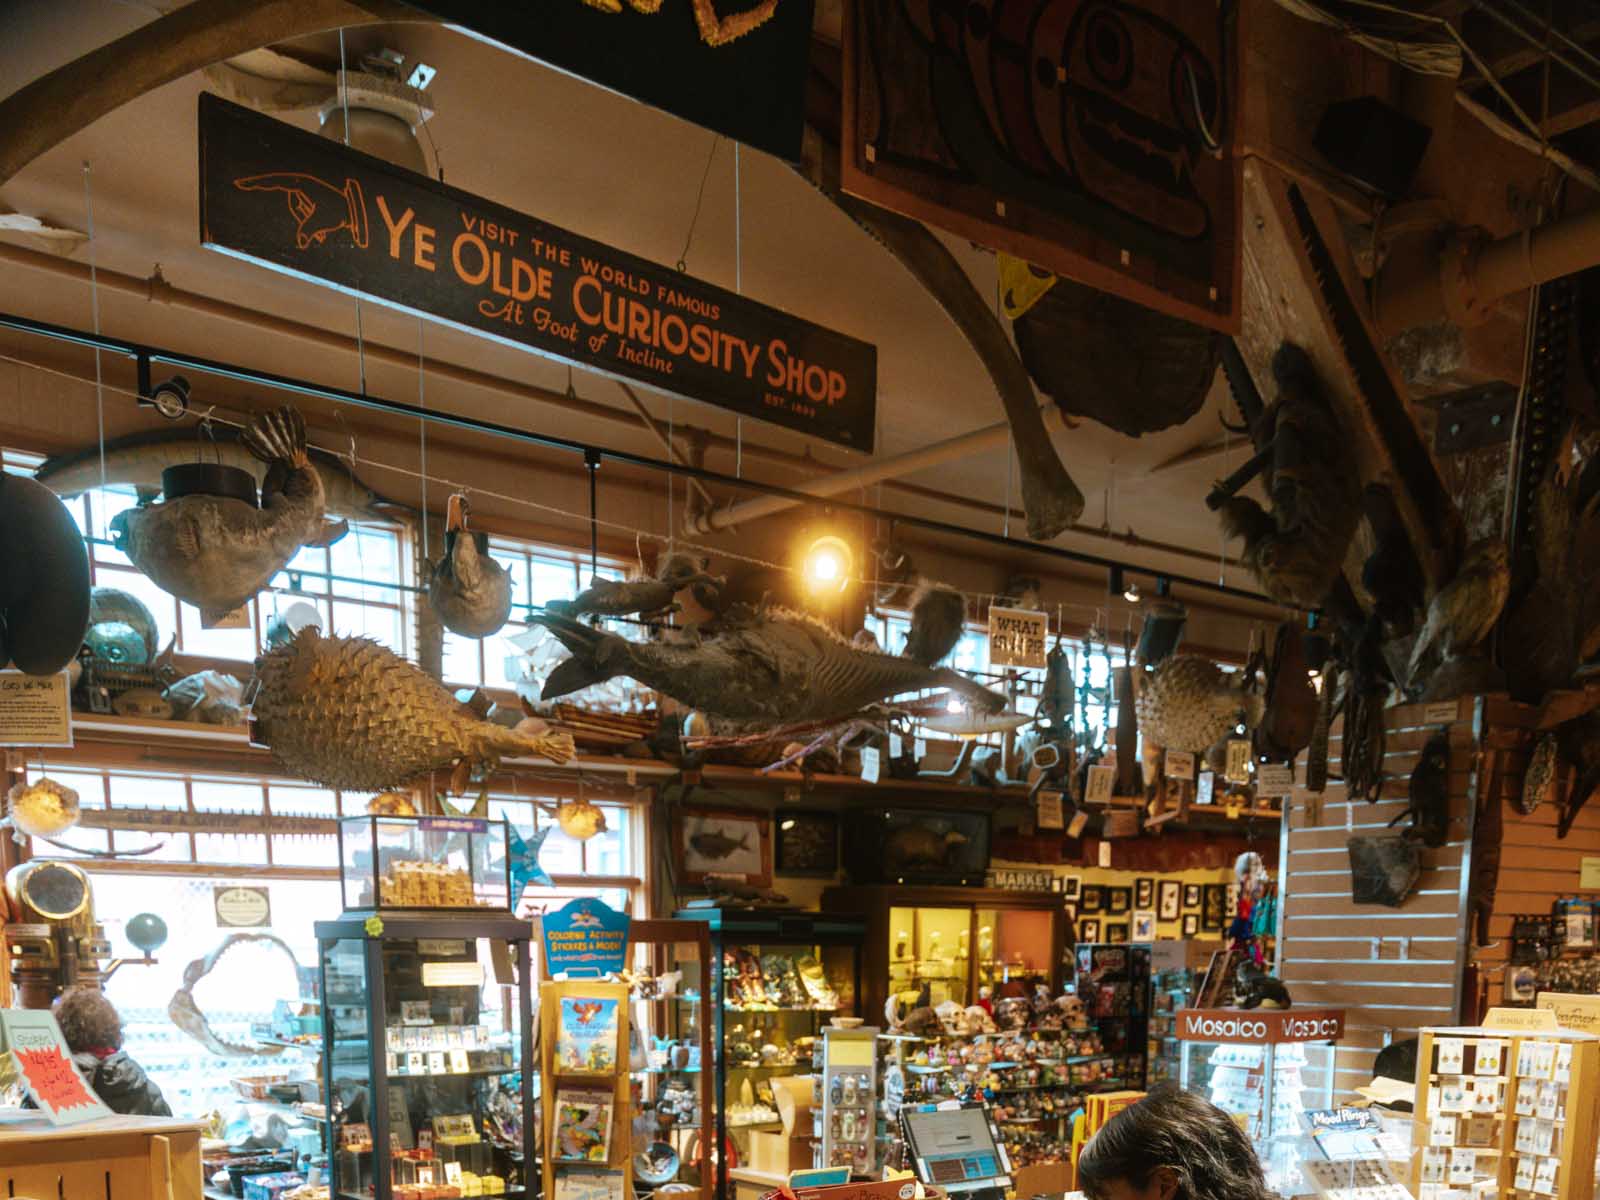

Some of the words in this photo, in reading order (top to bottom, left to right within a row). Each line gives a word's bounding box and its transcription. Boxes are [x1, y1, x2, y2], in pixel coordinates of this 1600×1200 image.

[461, 212, 519, 247] VISIT
[532, 238, 571, 267] THE
[581, 256, 650, 296] WORLD
[658, 285, 720, 320] FAMOUS
[376, 195, 436, 272] YE
[452, 232, 552, 302] OLDE
[572, 274, 761, 379] CURIOSITY
[767, 339, 847, 406] SHOP
[479, 300, 524, 325] At
[533, 308, 580, 342] Foot
[588, 334, 609, 353] of
[617, 340, 673, 374] Incline
[997, 616, 1041, 635] WHAT
[995, 871, 1051, 887] MARKET
[1186, 1015, 1268, 1038] Mosaico
[1313, 1109, 1341, 1127] Mood
[1340, 1108, 1370, 1129] Rings
